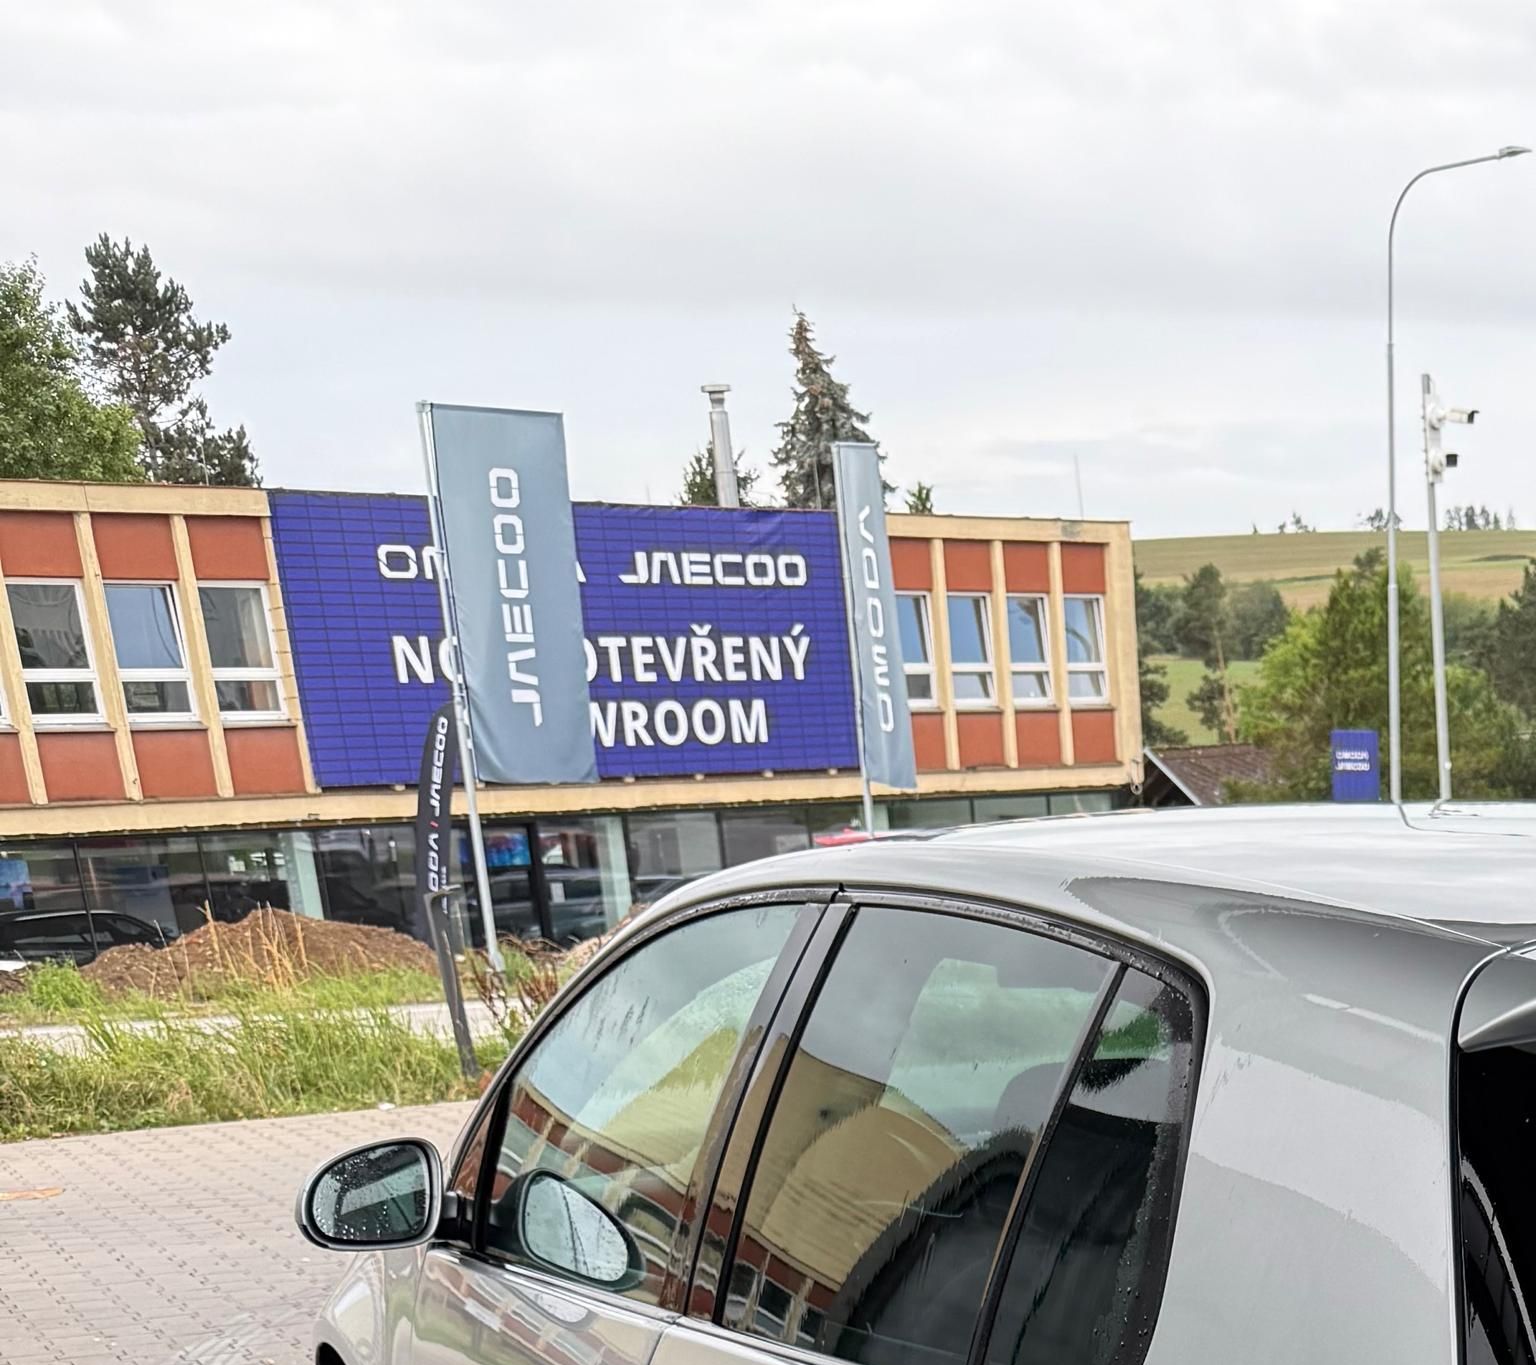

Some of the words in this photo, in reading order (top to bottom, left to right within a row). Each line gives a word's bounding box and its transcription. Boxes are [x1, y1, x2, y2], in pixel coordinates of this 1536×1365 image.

[489, 467, 543, 727] JAECOO
[618, 551, 807, 587] JAECOO
[858, 505, 895, 733] OMODA
